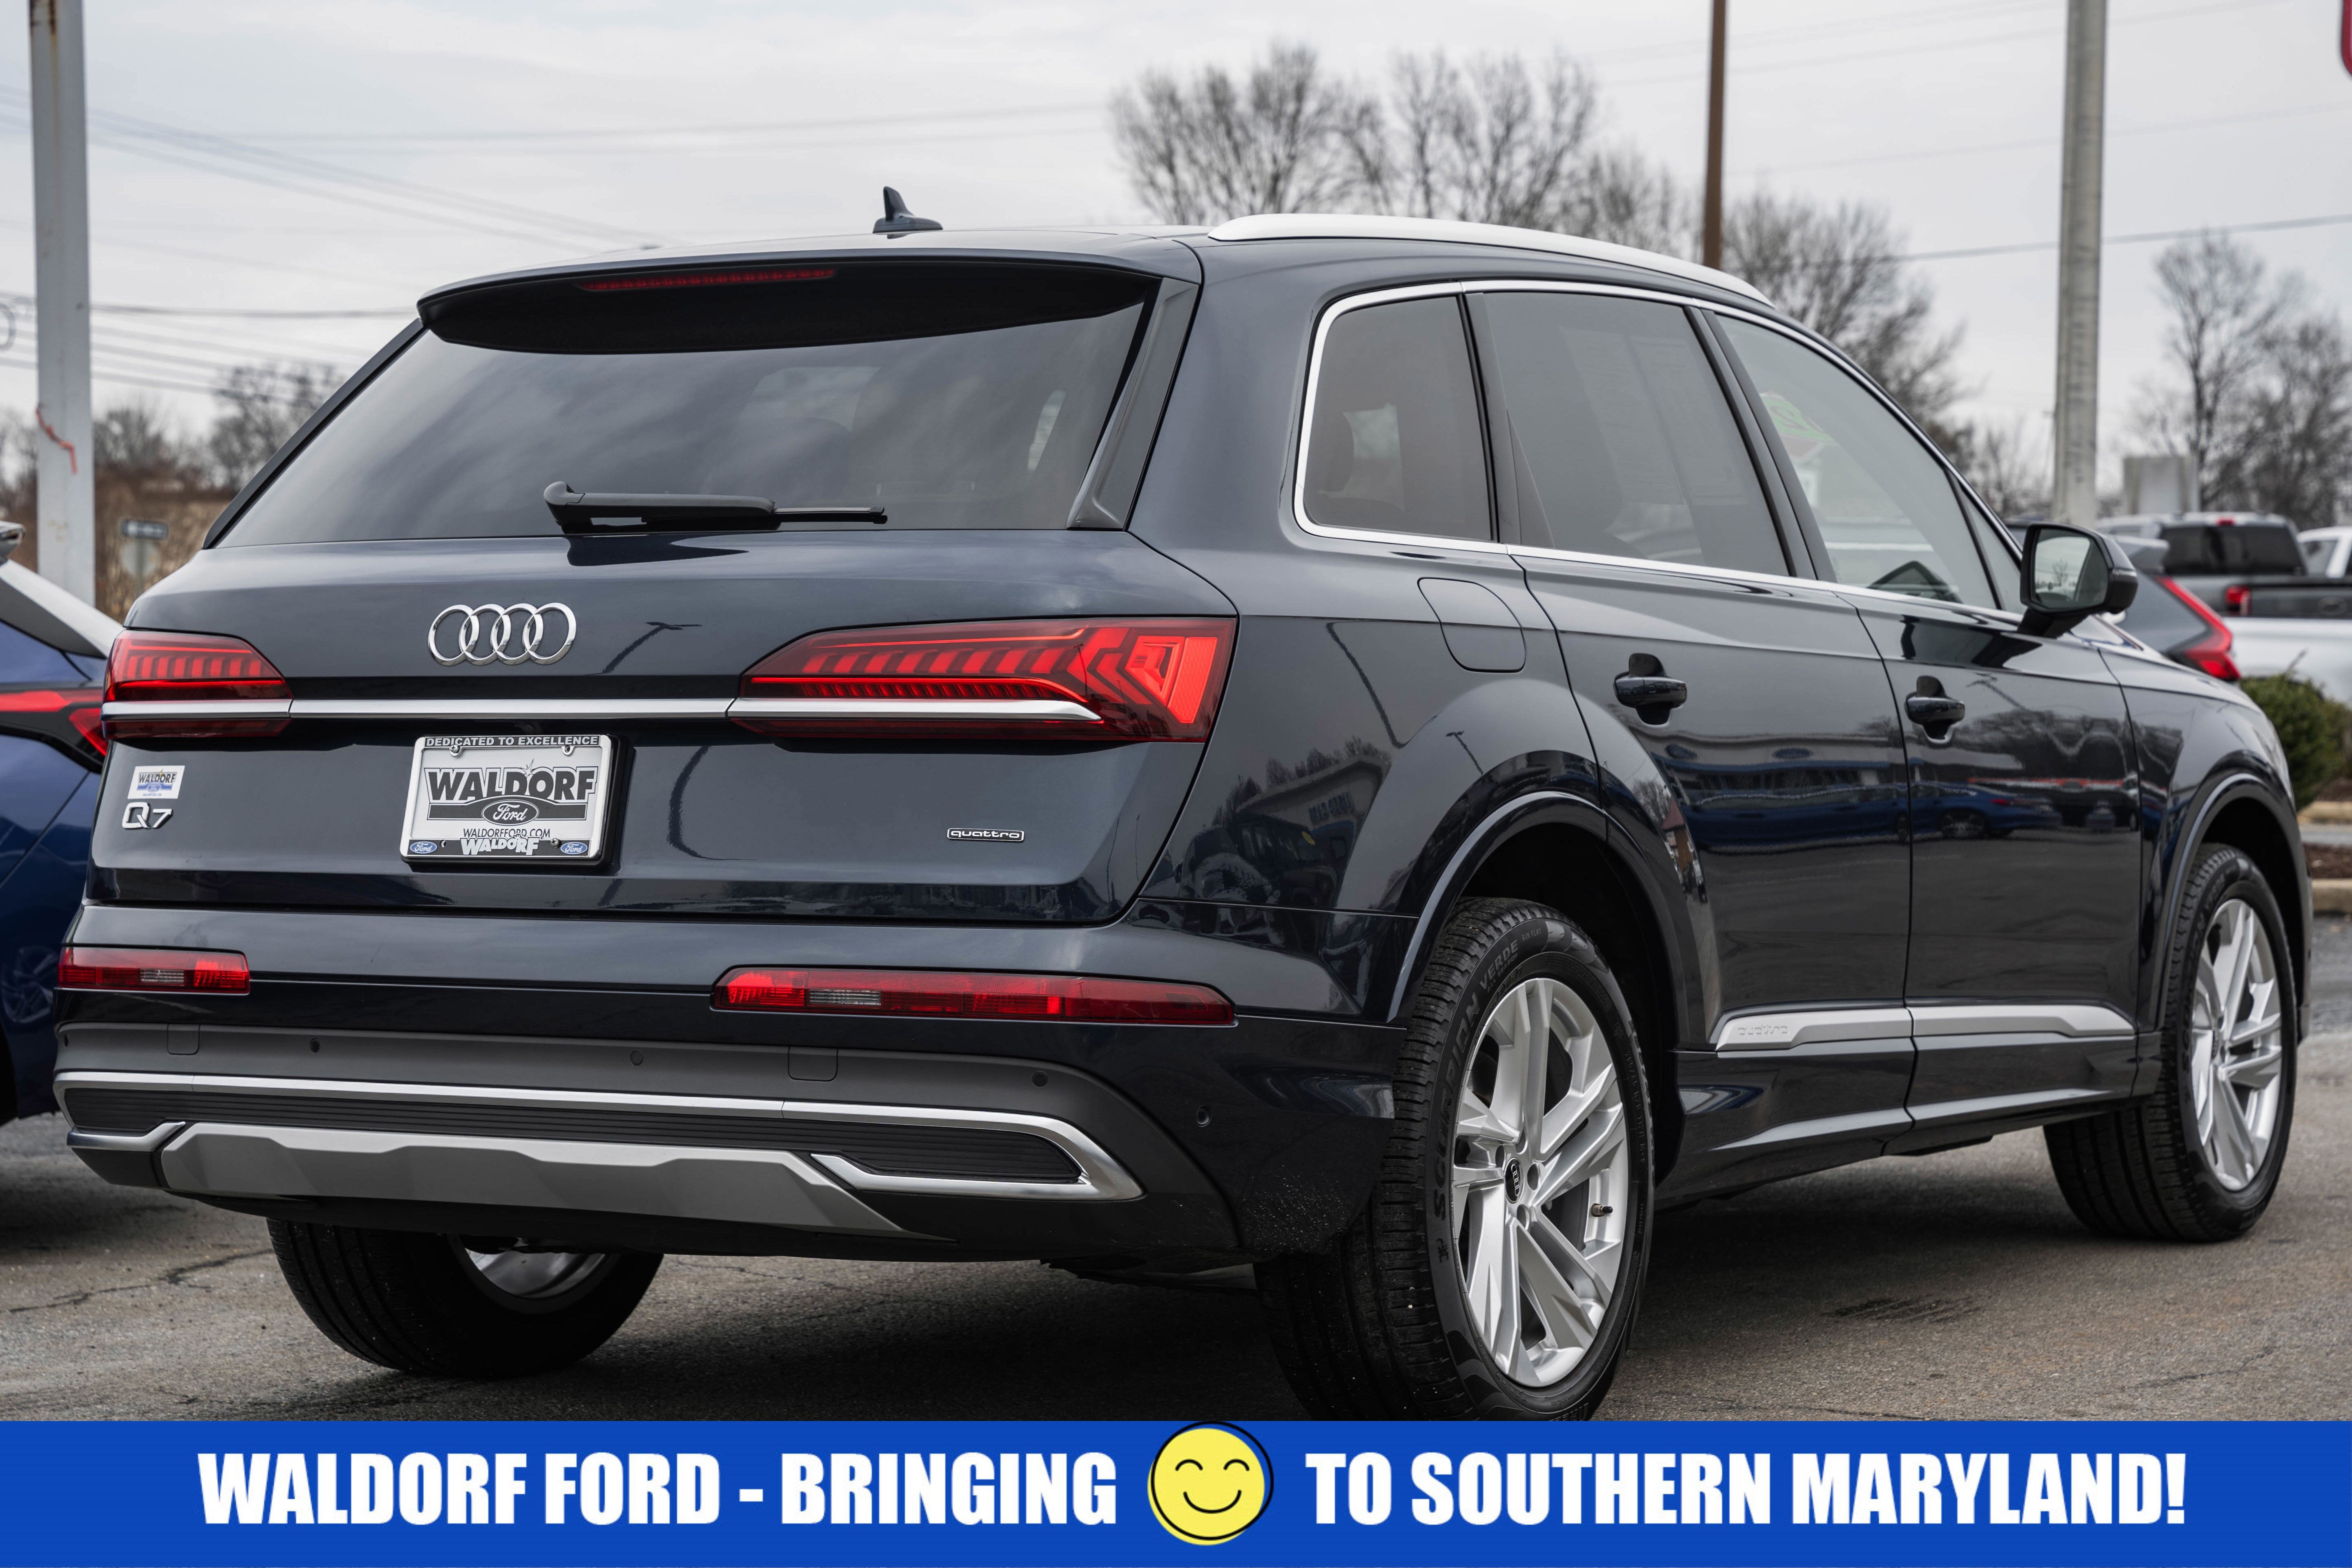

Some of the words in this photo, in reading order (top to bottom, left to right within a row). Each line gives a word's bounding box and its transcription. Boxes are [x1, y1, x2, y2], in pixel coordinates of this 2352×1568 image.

[426, 737, 494, 747] DEDICATED
[499, 737, 514, 746] TO
[517, 735, 599, 746] EXCELLENCE
[139, 773, 176, 784] WALDORF
[426, 769, 596, 801] WALDORF
[122, 801, 172, 829] Q7
[492, 803, 526, 822] Ford
[463, 828, 550, 838] WALDORFFORDCOM
[951, 830, 1020, 839] quattro
[414, 842, 434, 853] Ford
[460, 837, 541, 856] WALDORF
[565, 843, 584, 853] Ford
[1433, 993, 1481, 1221] SCORPION
[1480, 939, 1519, 990] VERDE
